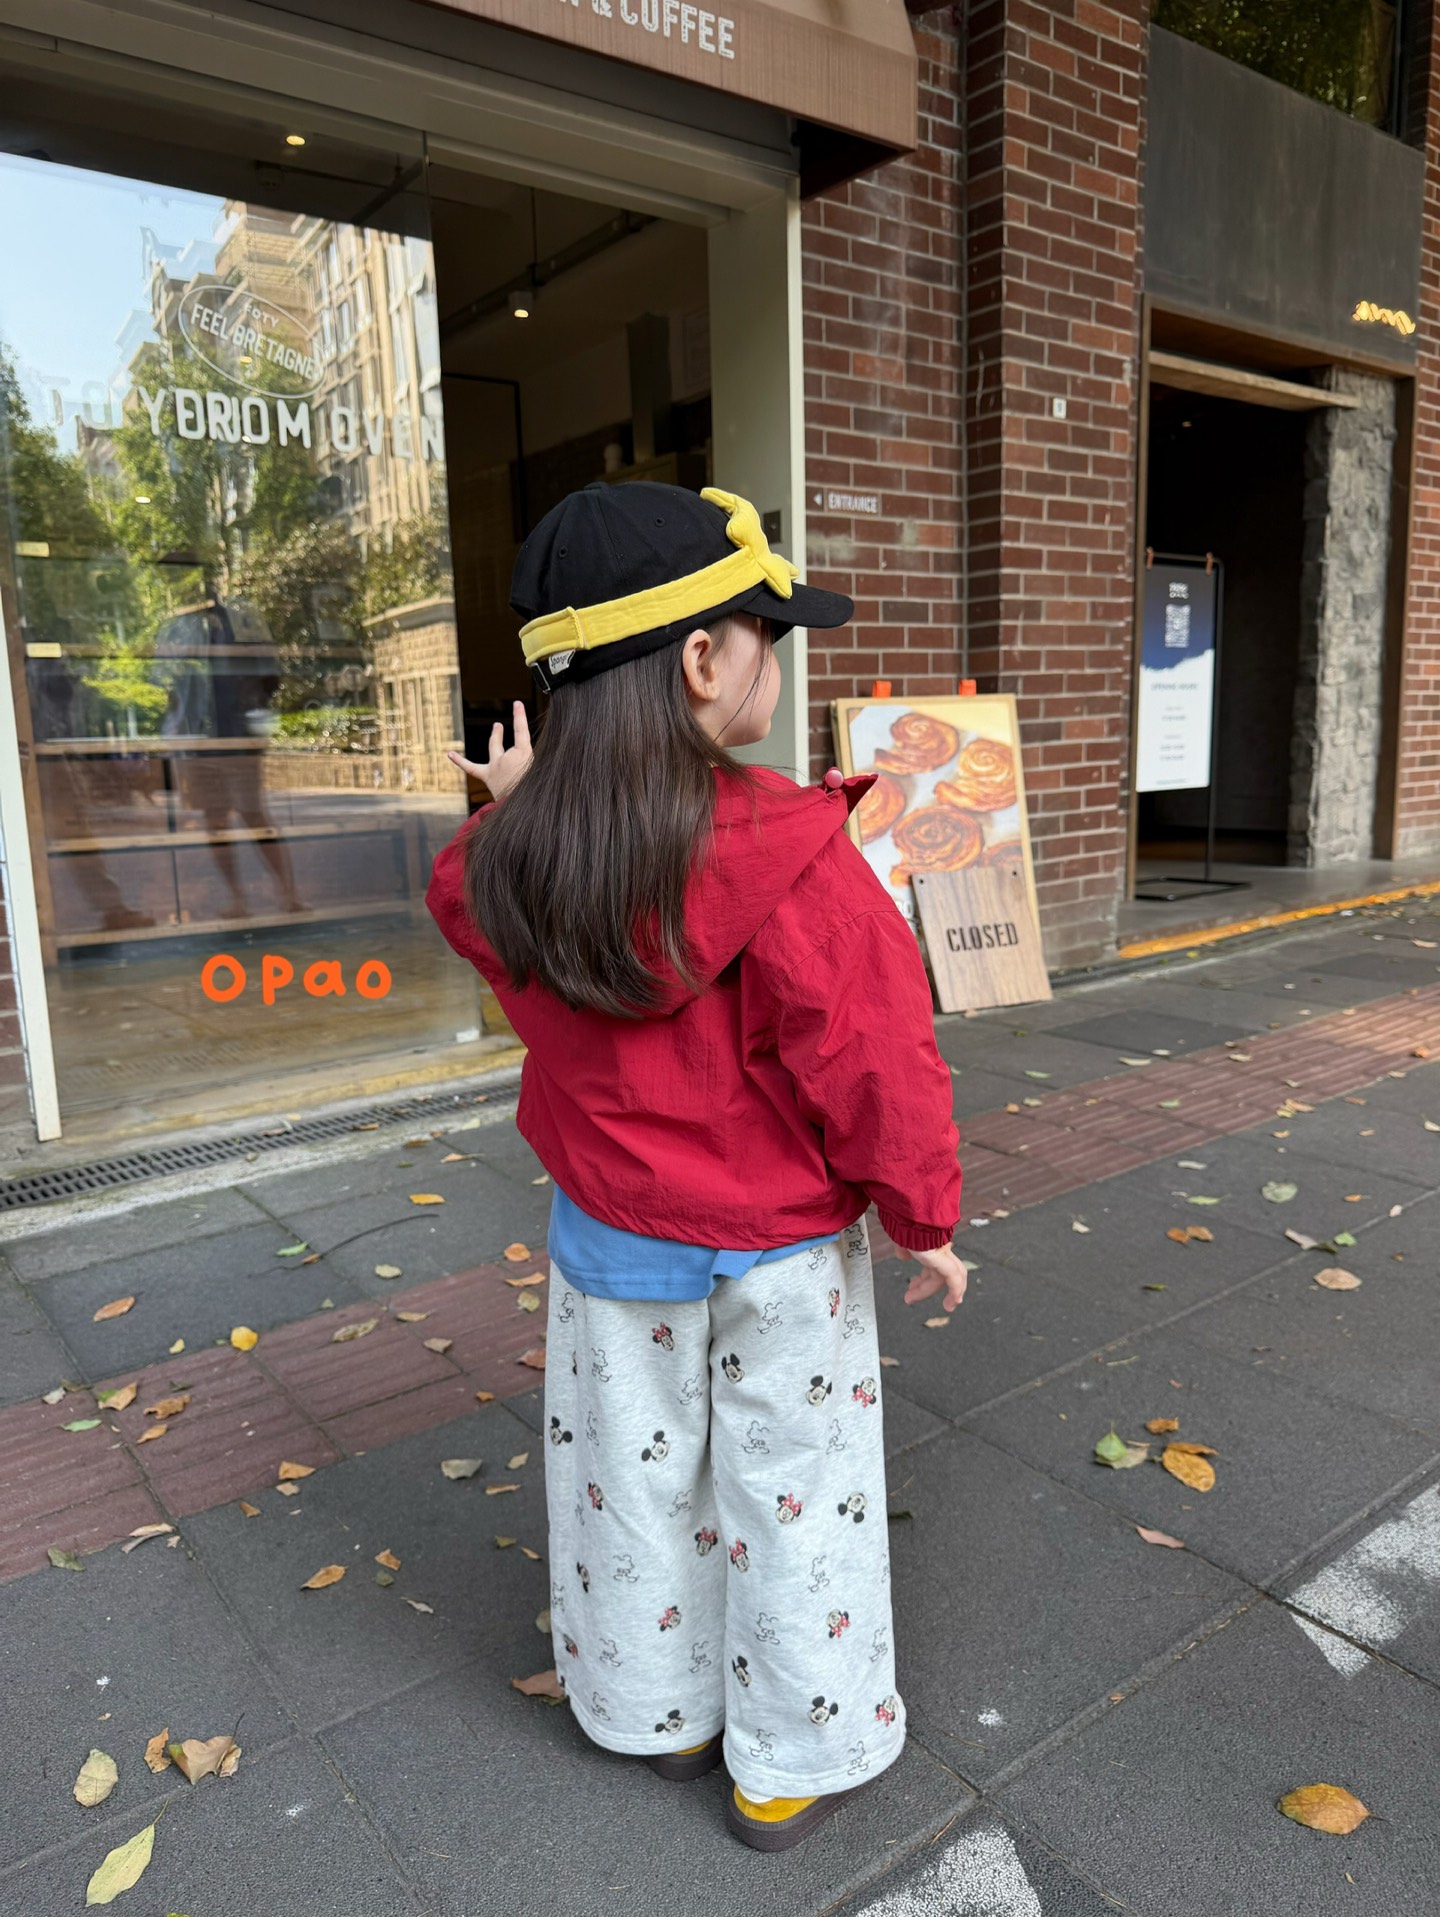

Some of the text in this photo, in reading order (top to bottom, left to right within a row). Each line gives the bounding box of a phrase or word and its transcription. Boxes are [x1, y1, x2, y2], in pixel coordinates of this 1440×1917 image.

[620, 0, 735, 59] COFFEE
[190, 303, 317, 381] FEEL BRETAGNE
[330, 405, 445, 462] OVEN
[828, 492, 878, 514] ENTRANCE
[946, 921, 1019, 953] CLOSED
